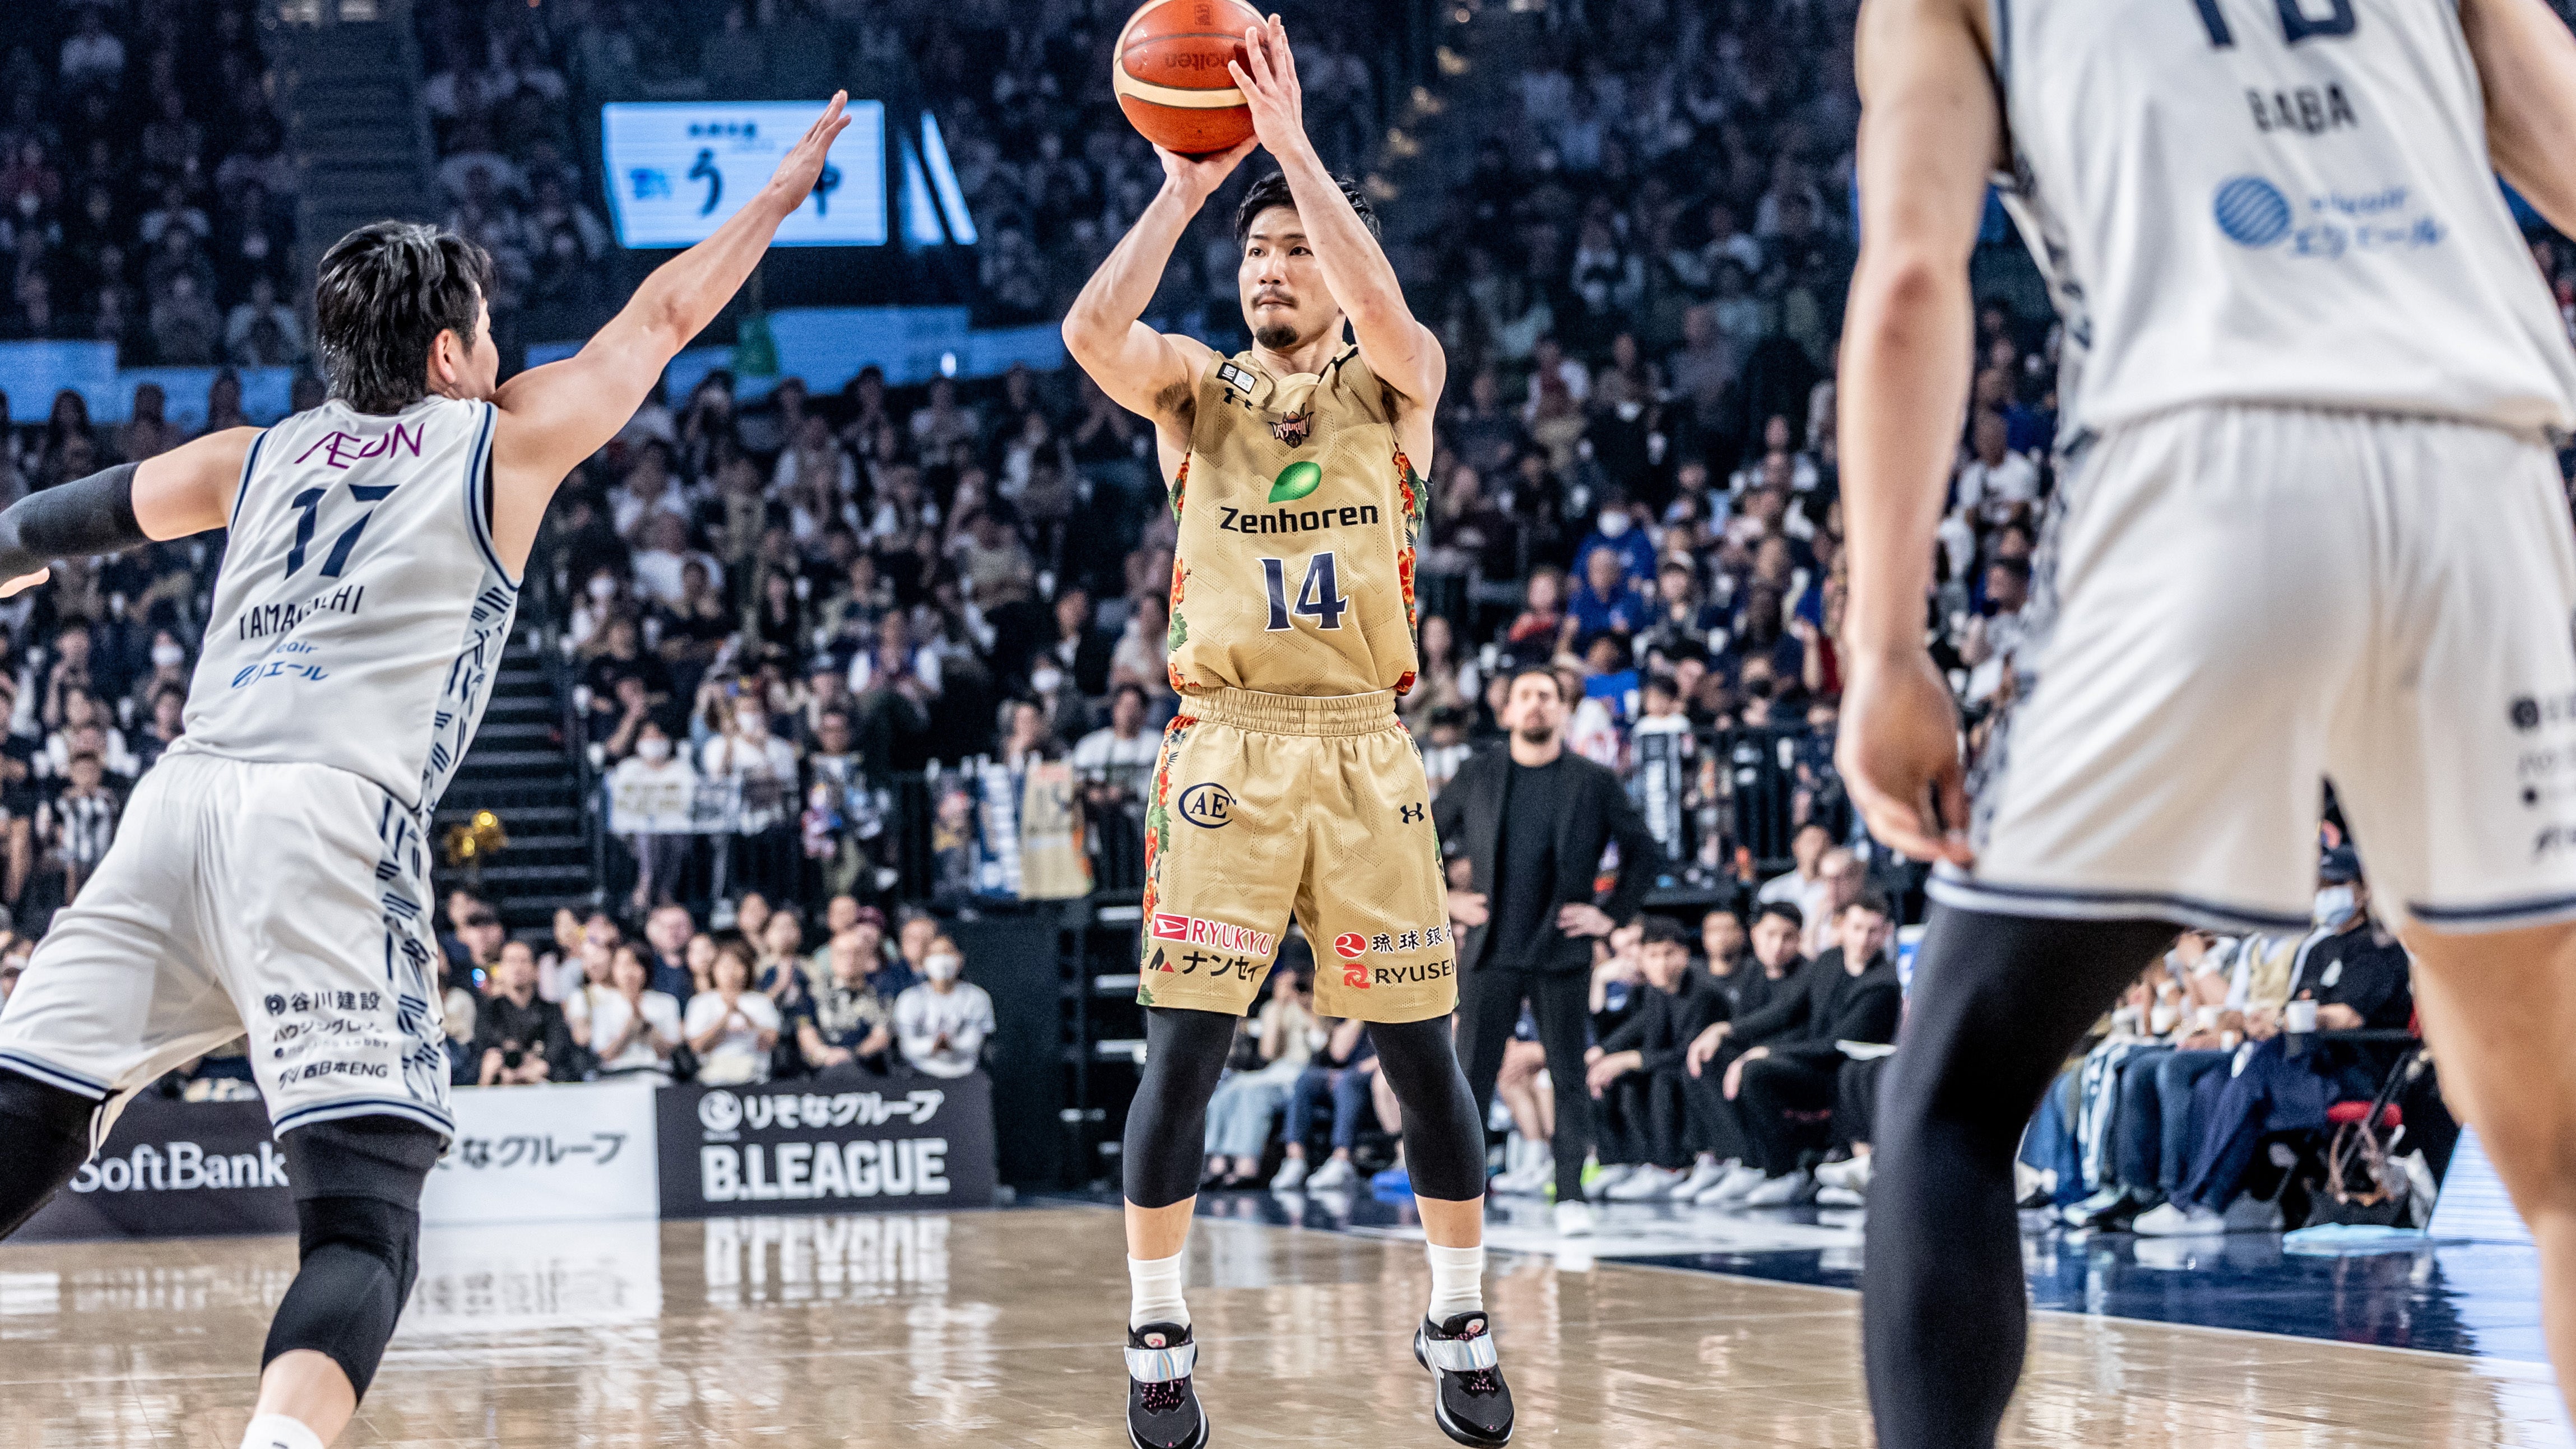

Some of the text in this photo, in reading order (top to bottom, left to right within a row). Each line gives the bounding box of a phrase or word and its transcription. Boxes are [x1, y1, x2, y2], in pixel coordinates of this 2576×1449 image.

[284, 484, 400, 580] 17
[1220, 505, 1378, 534] Zenhoren
[1255, 550, 1349, 632] 14
[240, 585, 365, 640] YAMAHI
[1190, 918, 1275, 956] RYUKYU
[1182, 951, 1266, 982] ナンセイ
[291, 991, 381, 1012] 谷川建設
[744, 1089, 945, 1130] りそなグループ
[69, 1141, 290, 1193] SoftBank
[437, 1132, 627, 1171] なグループ
[700, 1137, 951, 1202] B.LEAGUE
